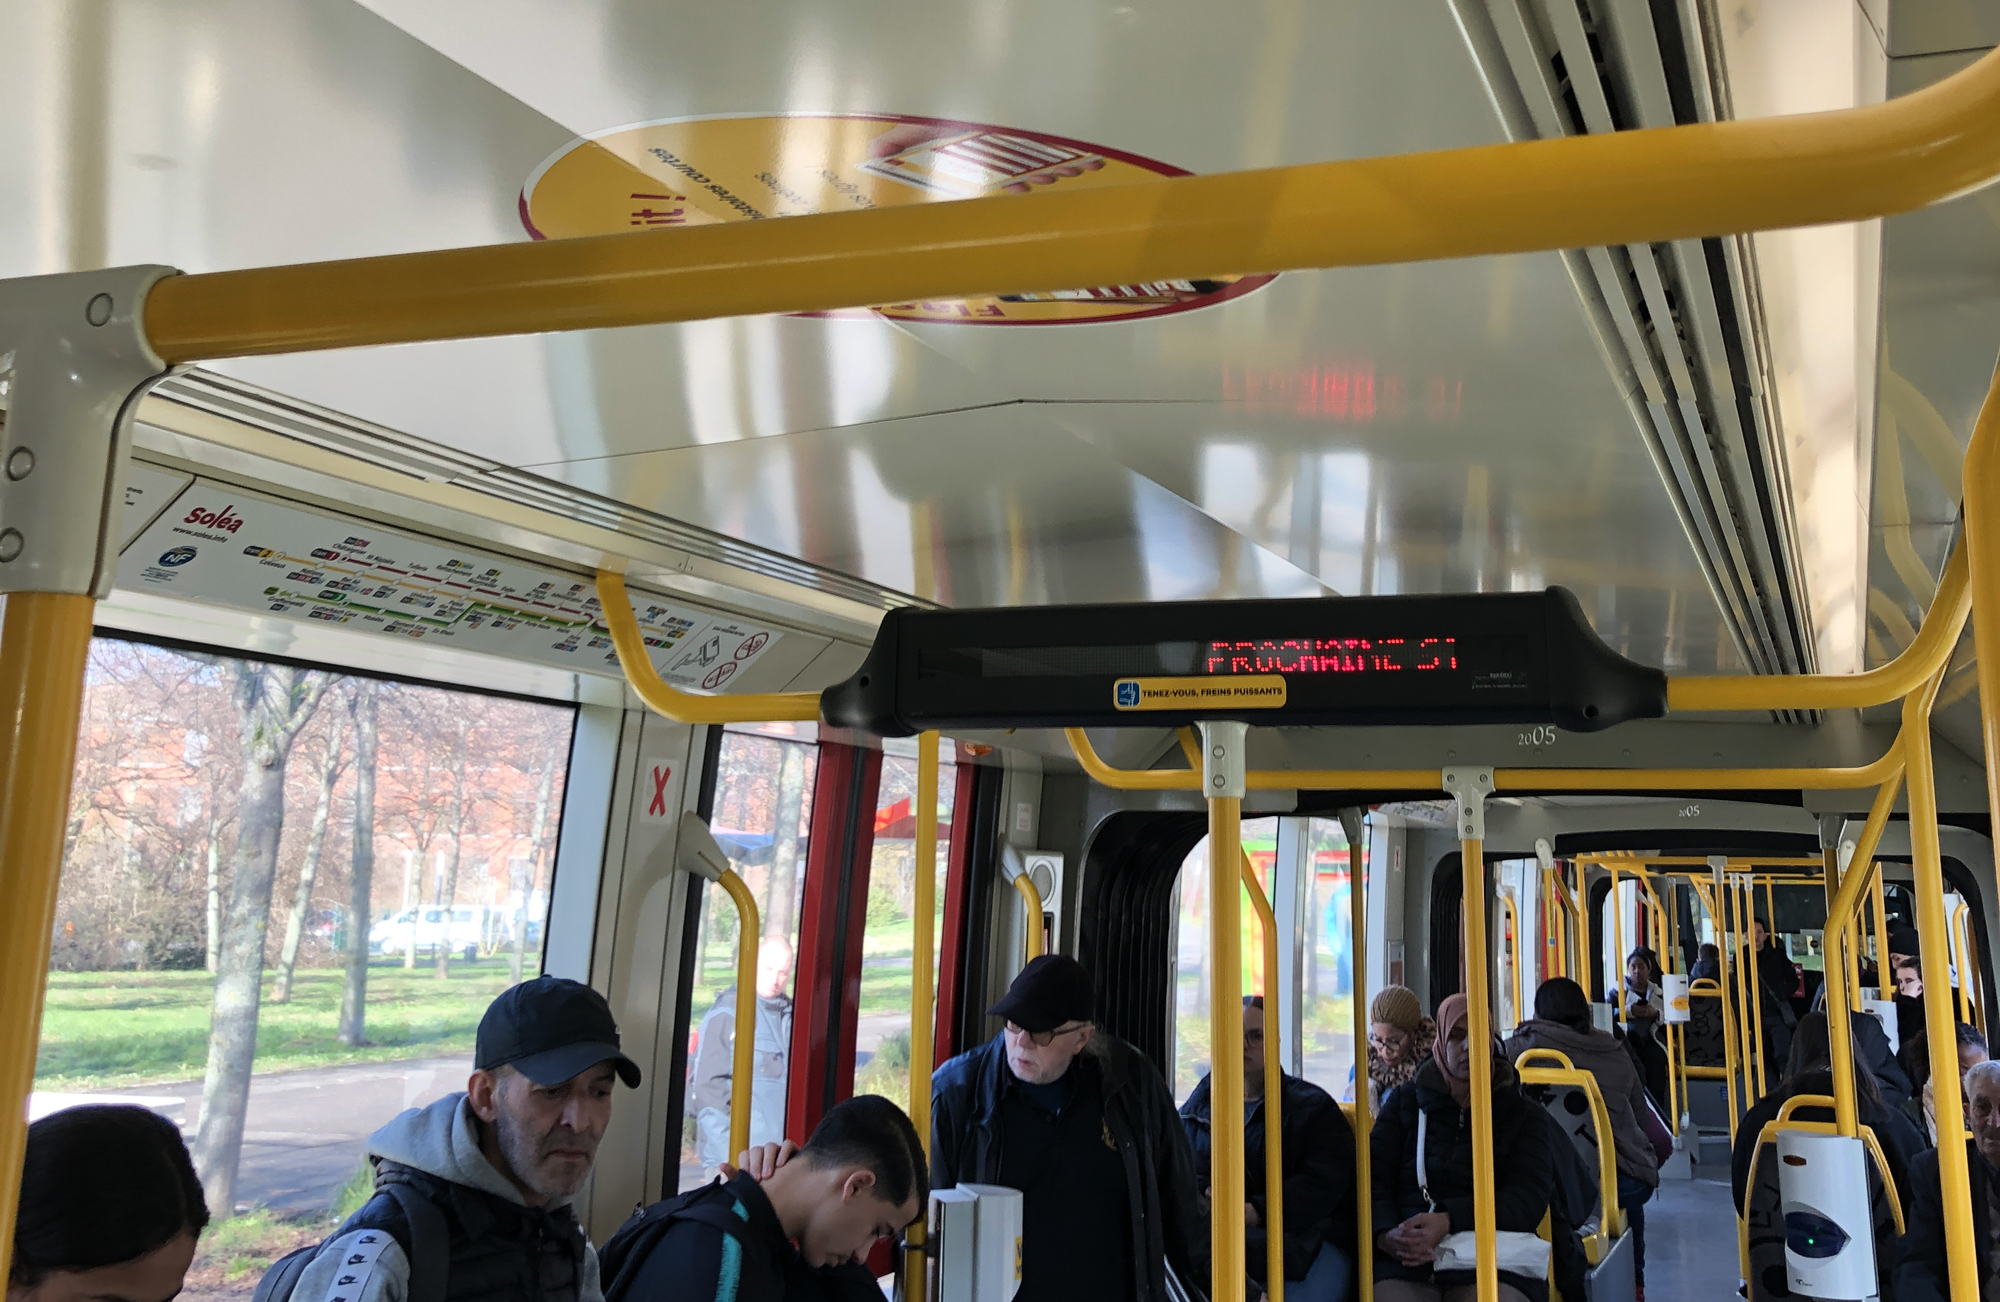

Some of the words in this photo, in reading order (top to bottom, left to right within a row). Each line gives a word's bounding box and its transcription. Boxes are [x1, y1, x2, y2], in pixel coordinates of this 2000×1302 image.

[1208, 639, 1404, 673] PROCHAINE
[1142, 689, 1199, 698] TENEZ-VOUS,
[1200, 687, 1232, 697] FREINS
[1234, 686, 1283, 696] PUISSANTS
[1518, 725, 1556, 746] 2005
